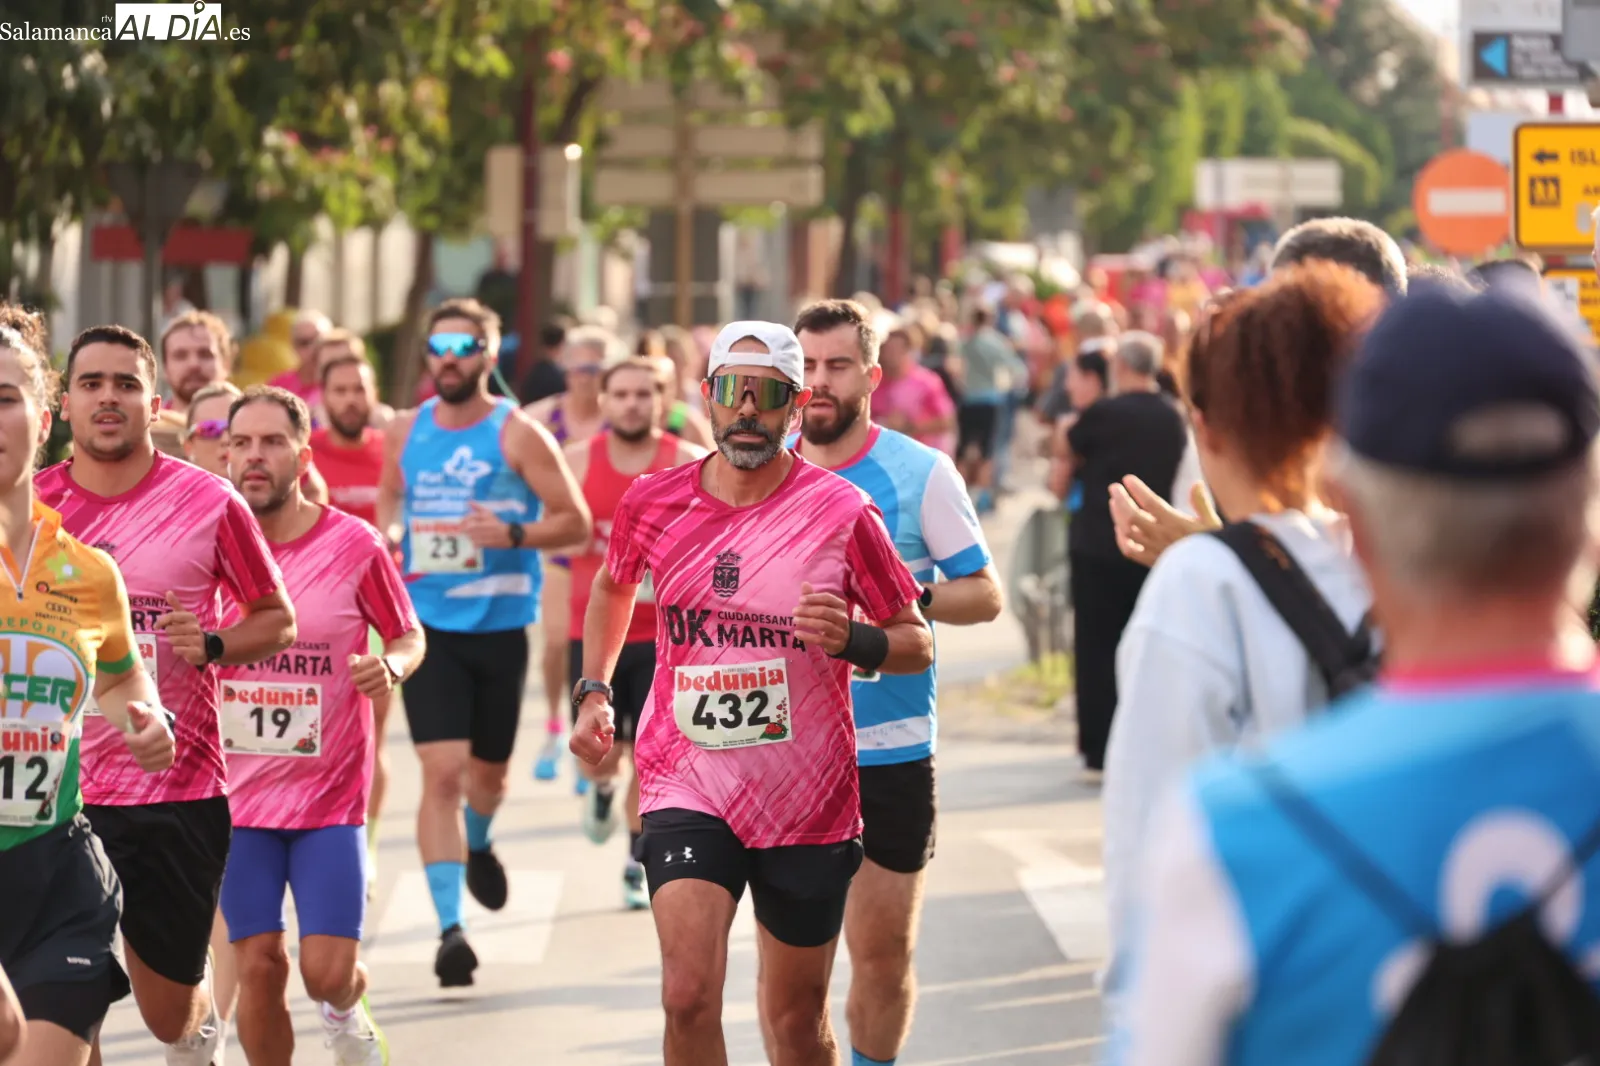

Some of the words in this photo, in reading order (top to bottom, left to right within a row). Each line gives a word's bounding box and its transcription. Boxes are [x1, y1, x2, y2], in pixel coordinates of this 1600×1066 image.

[430, 536, 458, 559] 23
[717, 611, 797, 627] CIUDADESANT
[717, 623, 806, 652] MARTA
[677, 667, 785, 692] bedunia
[250, 707, 292, 739] 19
[692, 690, 771, 731] 432
